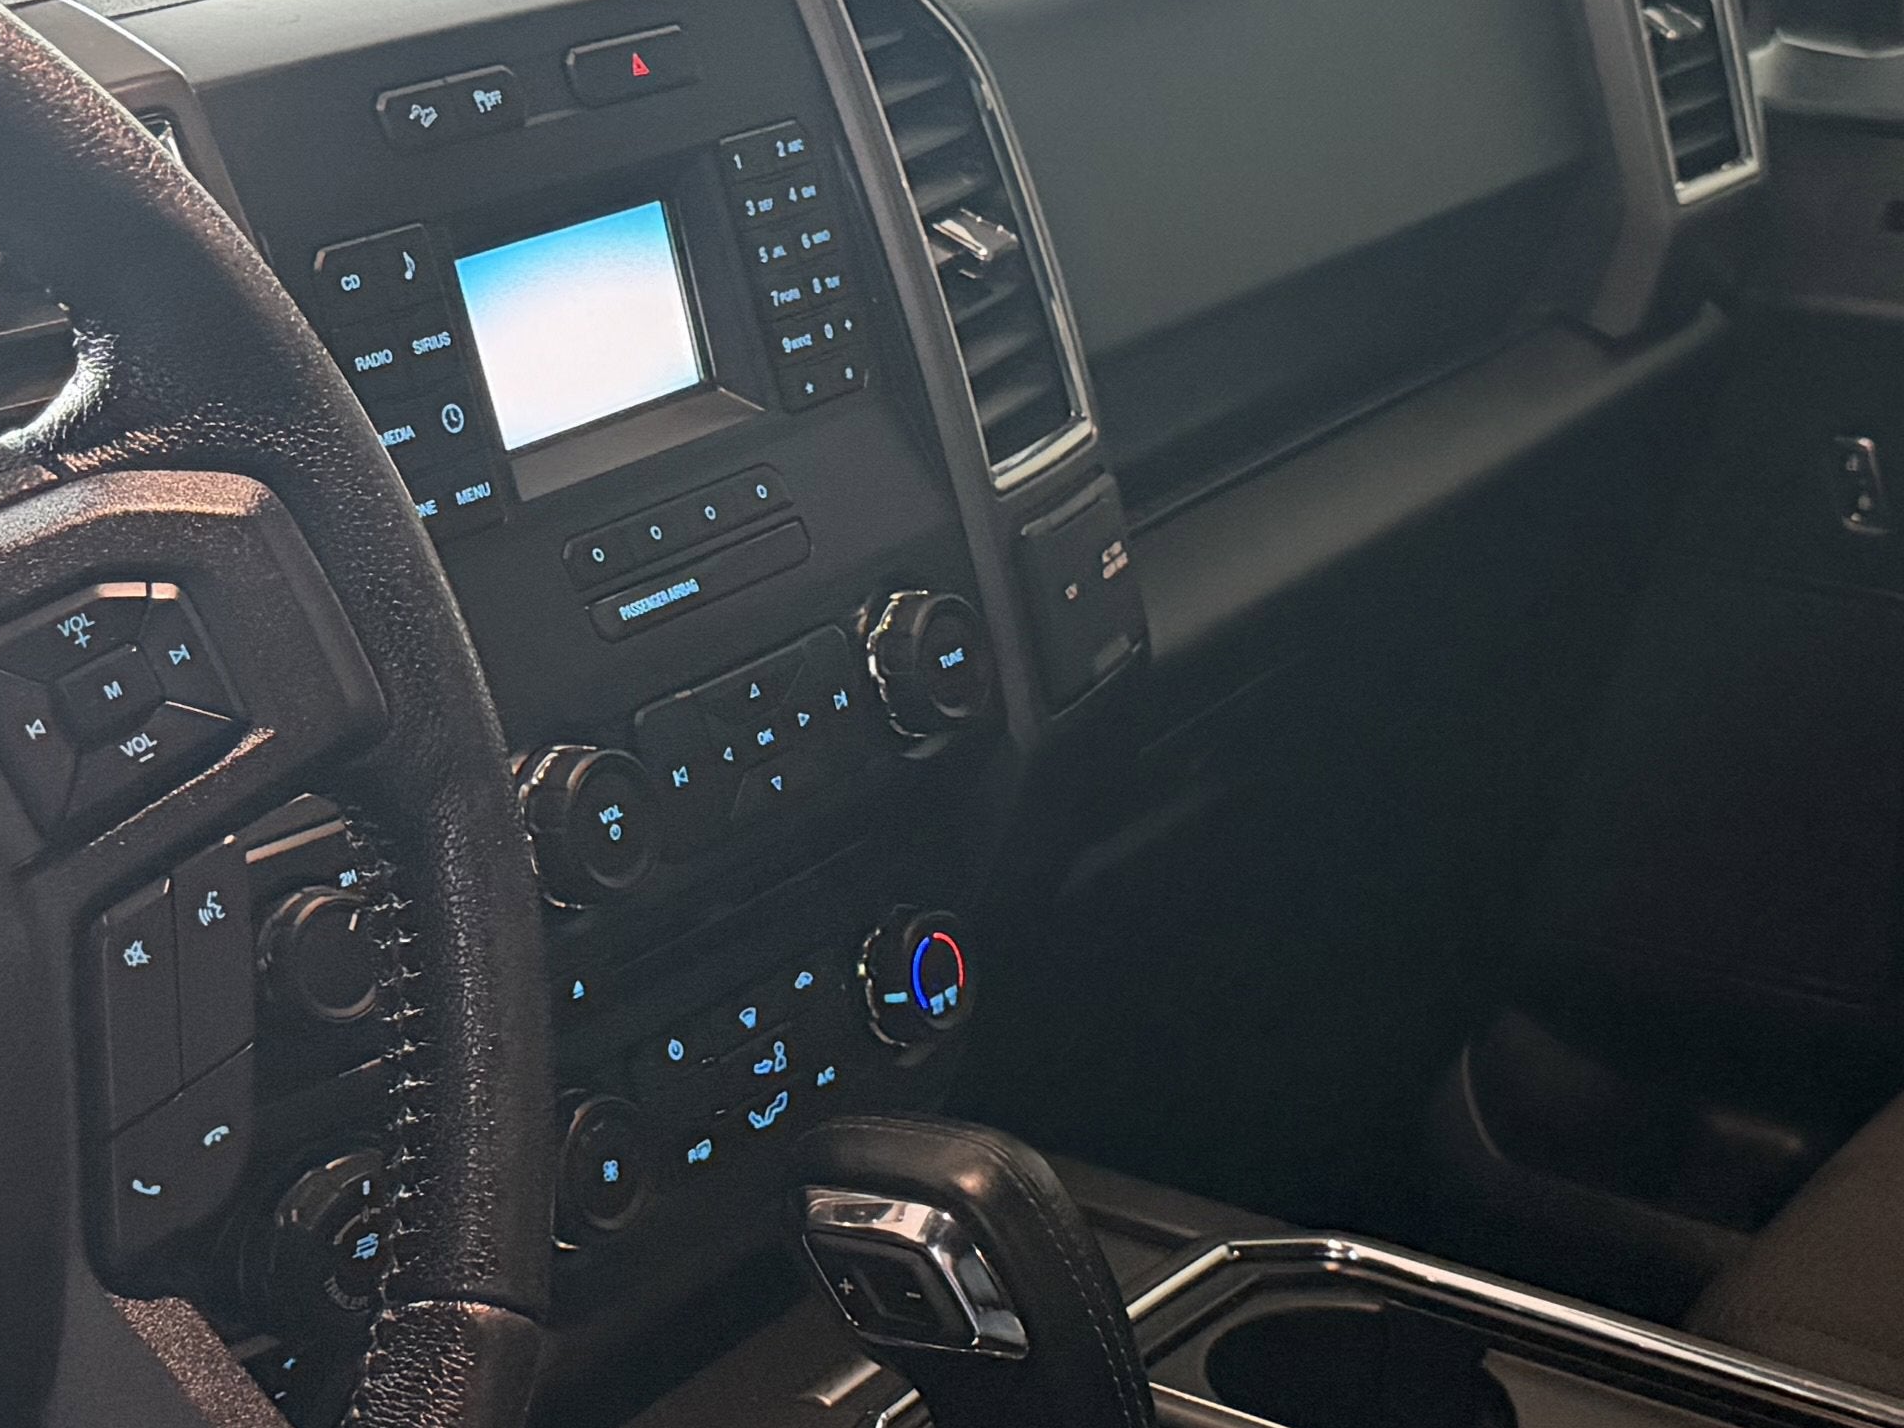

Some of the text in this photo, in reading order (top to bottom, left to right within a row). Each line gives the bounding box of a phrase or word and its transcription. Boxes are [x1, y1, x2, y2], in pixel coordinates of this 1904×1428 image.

[776, 141, 787, 157] 2
[734, 154, 742, 170] 1
[789, 187, 797, 202] 4
[746, 200, 755, 216] 3
[801, 233, 811, 249] 6
[759, 246, 769, 263] 5
[341, 274, 360, 291] CD
[812, 277, 822, 294] 8
[824, 323, 834, 340] 0
[412, 332, 451, 355] SIRIUS
[355, 349, 393, 372] RADIO
[455, 482, 491, 506] MENU
[619, 578, 700, 621] PASSENGER AIRBAG
[57, 613, 95, 636] VOL
[939, 647, 964, 668] TUNE
[103, 680, 123, 700] M
[119, 733, 158, 757] VOL
[757, 727, 774, 745] OK
[599, 805, 623, 824] VOL
